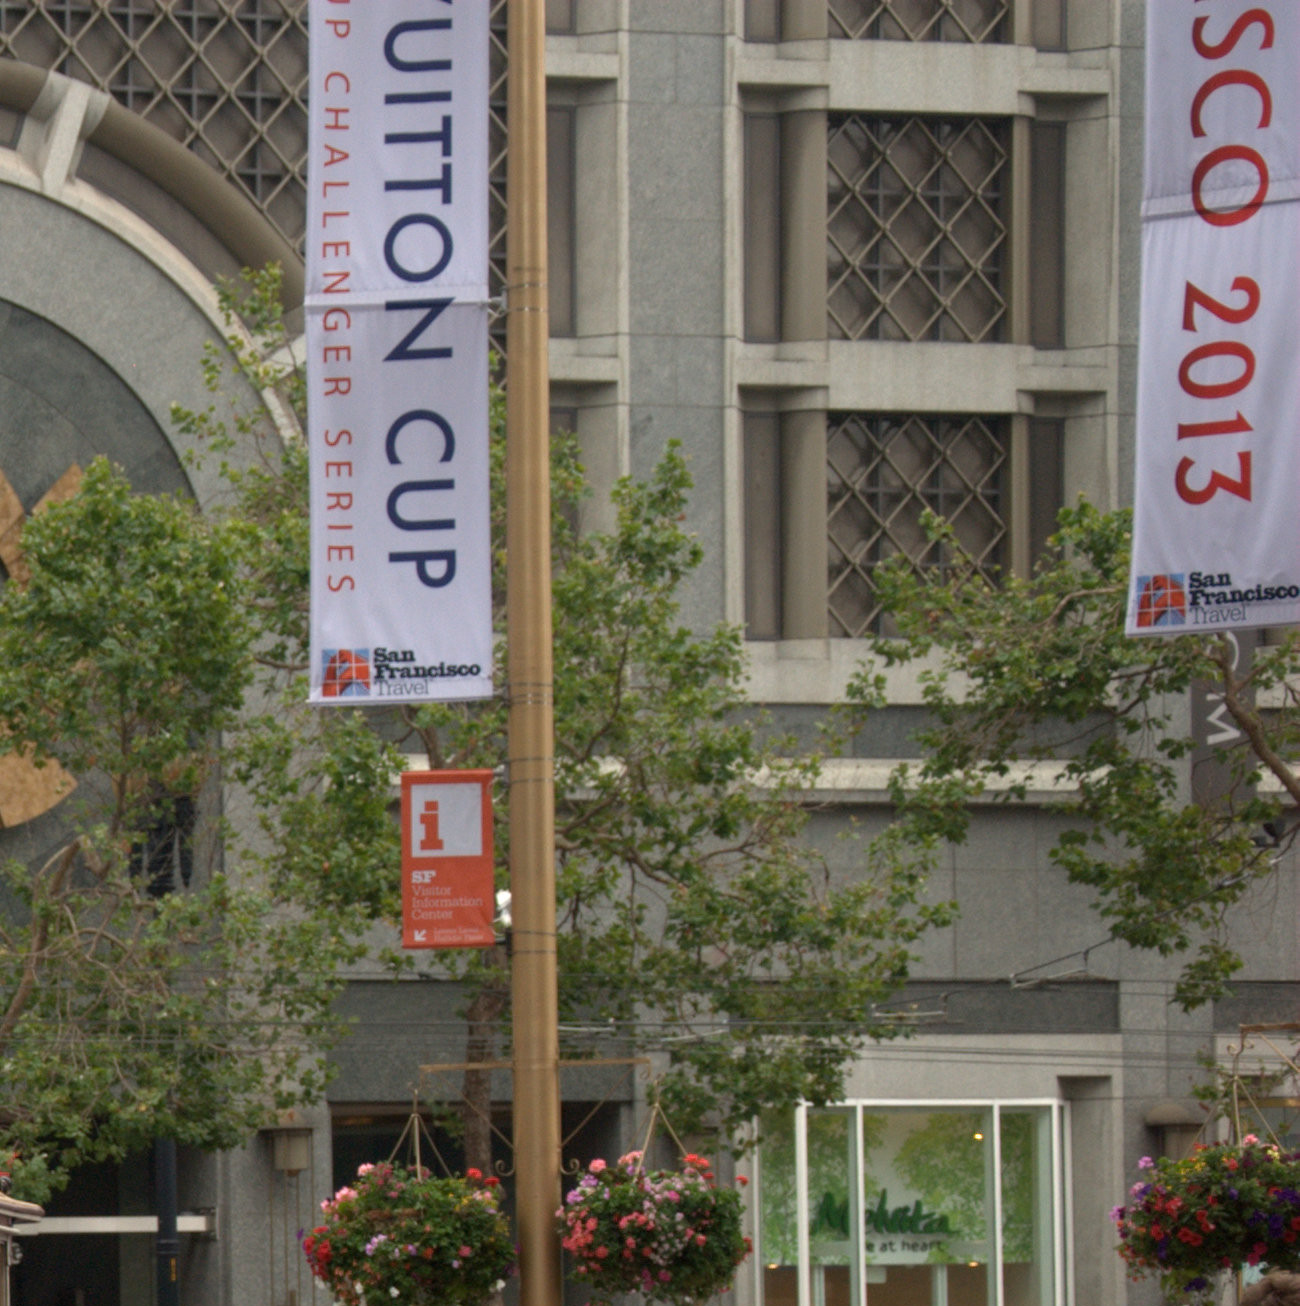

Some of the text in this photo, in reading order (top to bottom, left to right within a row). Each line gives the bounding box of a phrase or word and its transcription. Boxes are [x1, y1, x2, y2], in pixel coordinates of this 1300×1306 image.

[322, 71, 352, 397] CHALLENGER
[1175, 0, 1275, 506] SCO 2013
[382, 0, 457, 588] UITTON CUP
[324, 429, 355, 592] SERIES
[1189, 572, 1232, 589] San
[1189, 583, 1300, 606] Francisco
[1189, 604, 1247, 625] Travel
[374, 648, 416, 663] San
[374, 663, 481, 680] Francisco
[374, 678, 429, 696] Travel
[412, 870, 436, 884] SF
[412, 885, 453, 897] Visitor
[412, 896, 483, 909] Information
[412, 908, 454, 921] Center
[880, 1240, 897, 1253] at
[901, 1240, 943, 1253] heart
